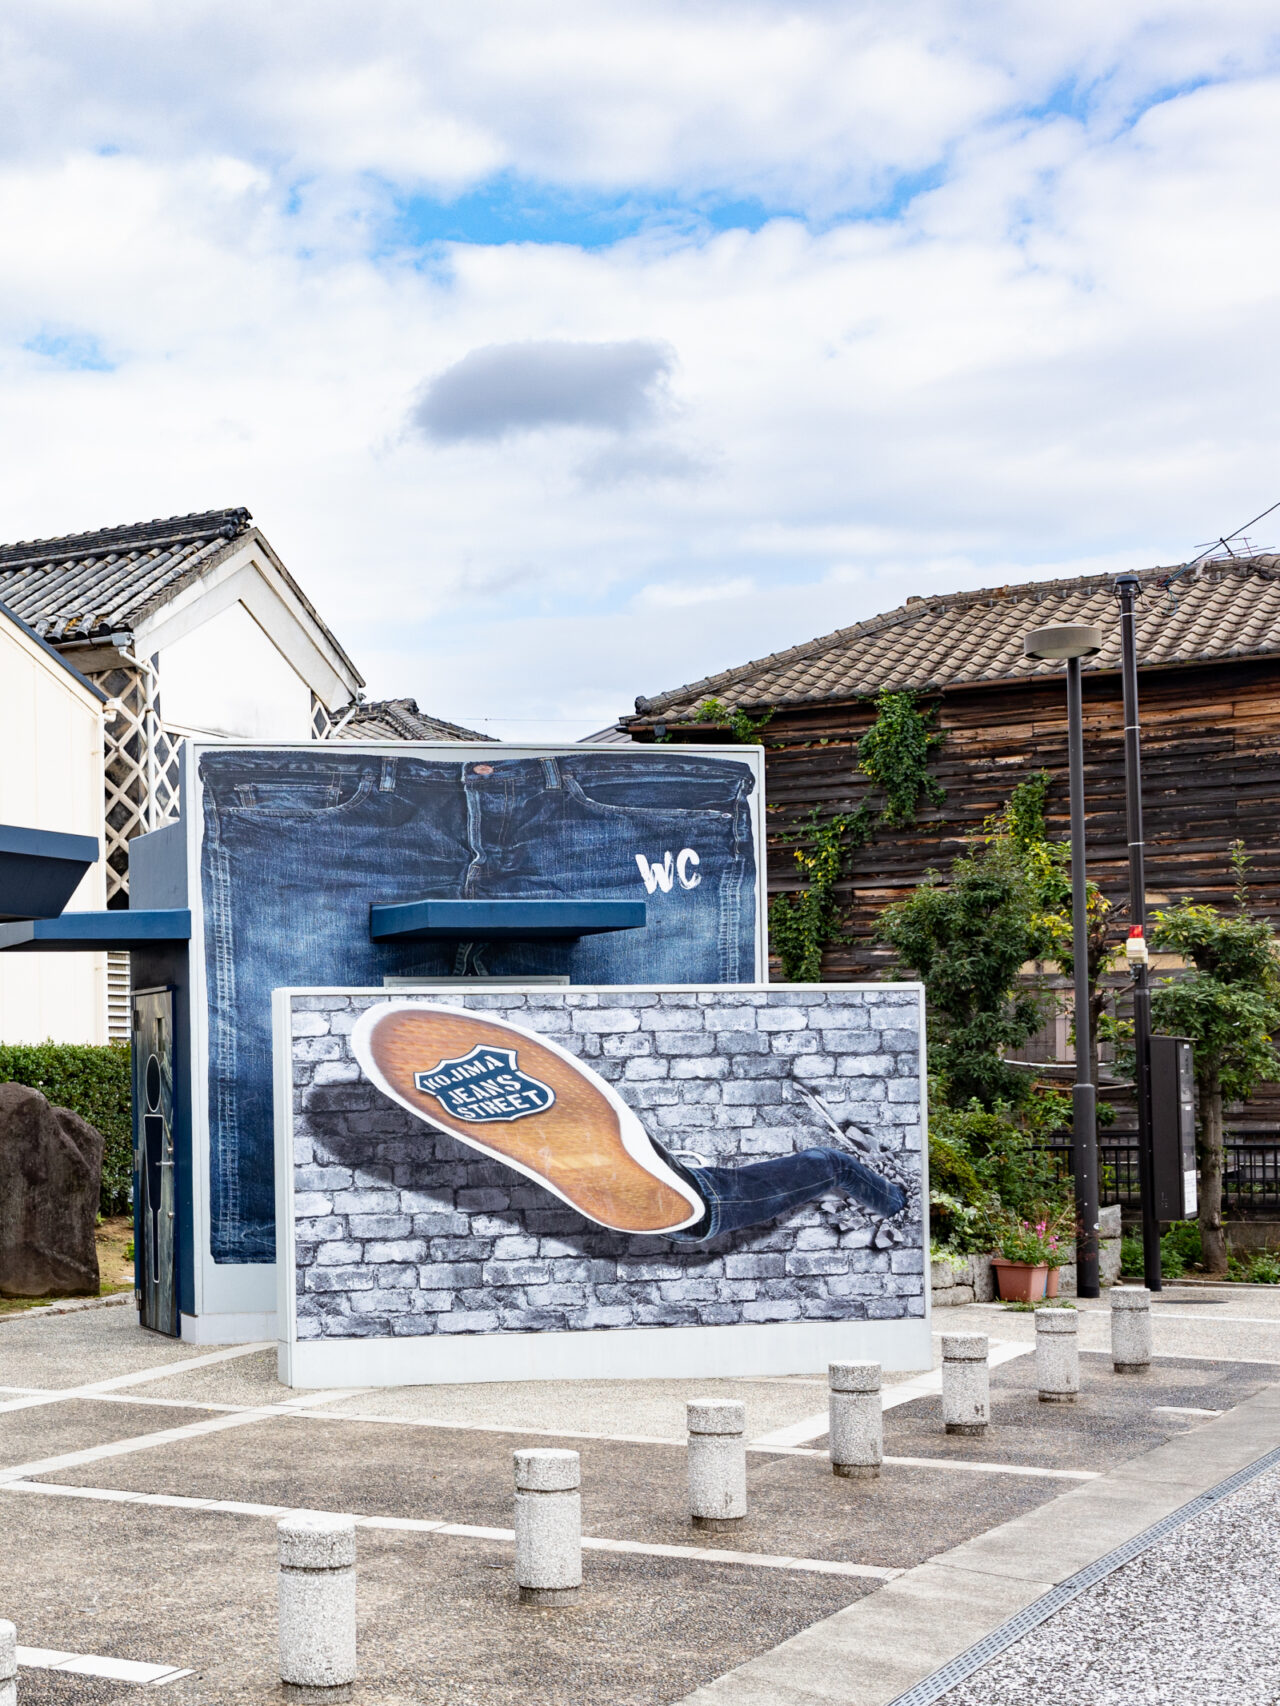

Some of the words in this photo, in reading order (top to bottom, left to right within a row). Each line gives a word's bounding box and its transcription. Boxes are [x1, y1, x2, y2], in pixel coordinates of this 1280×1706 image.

[634, 847, 703, 895] WC
[422, 1055, 506, 1091] KOJIMA
[448, 1074, 522, 1105] JEANS
[456, 1089, 545, 1119] STREET
